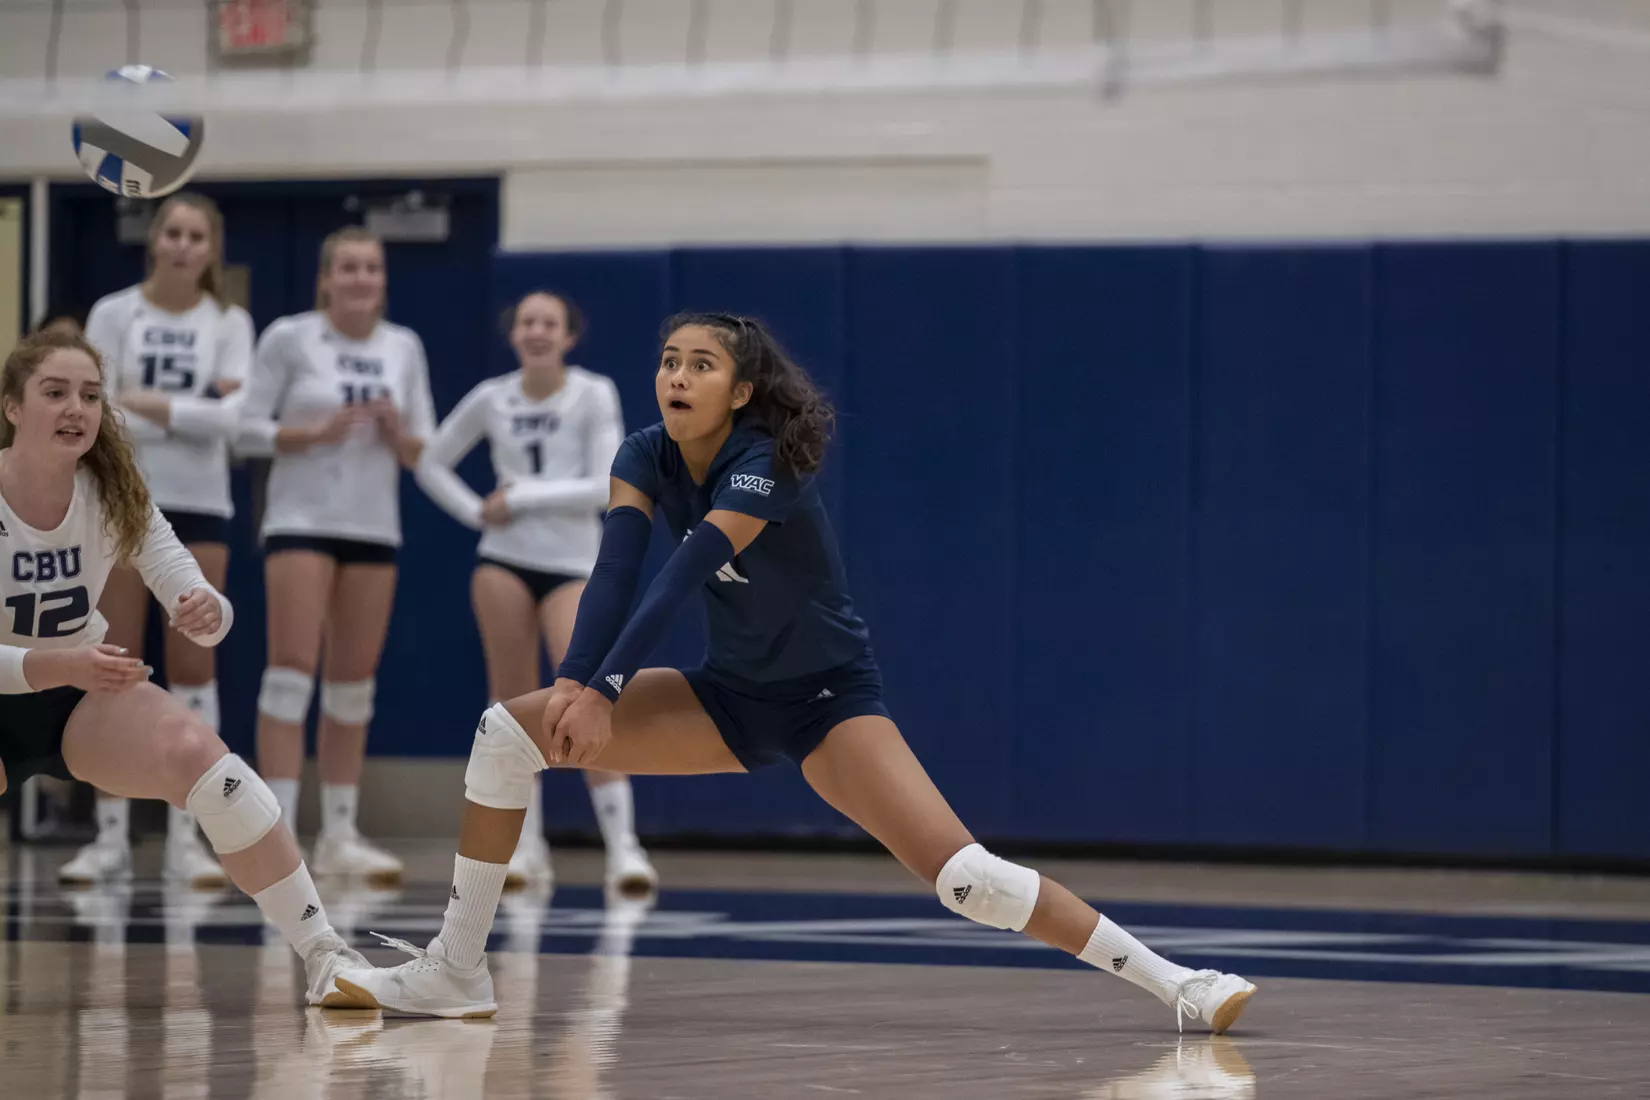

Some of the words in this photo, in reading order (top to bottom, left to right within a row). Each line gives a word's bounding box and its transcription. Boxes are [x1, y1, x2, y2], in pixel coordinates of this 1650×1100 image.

[138, 353, 197, 391] 15
[522, 441, 543, 475] 1
[731, 474, 776, 495] WAC
[12, 544, 82, 583] CBU
[5, 585, 90, 638] 12
